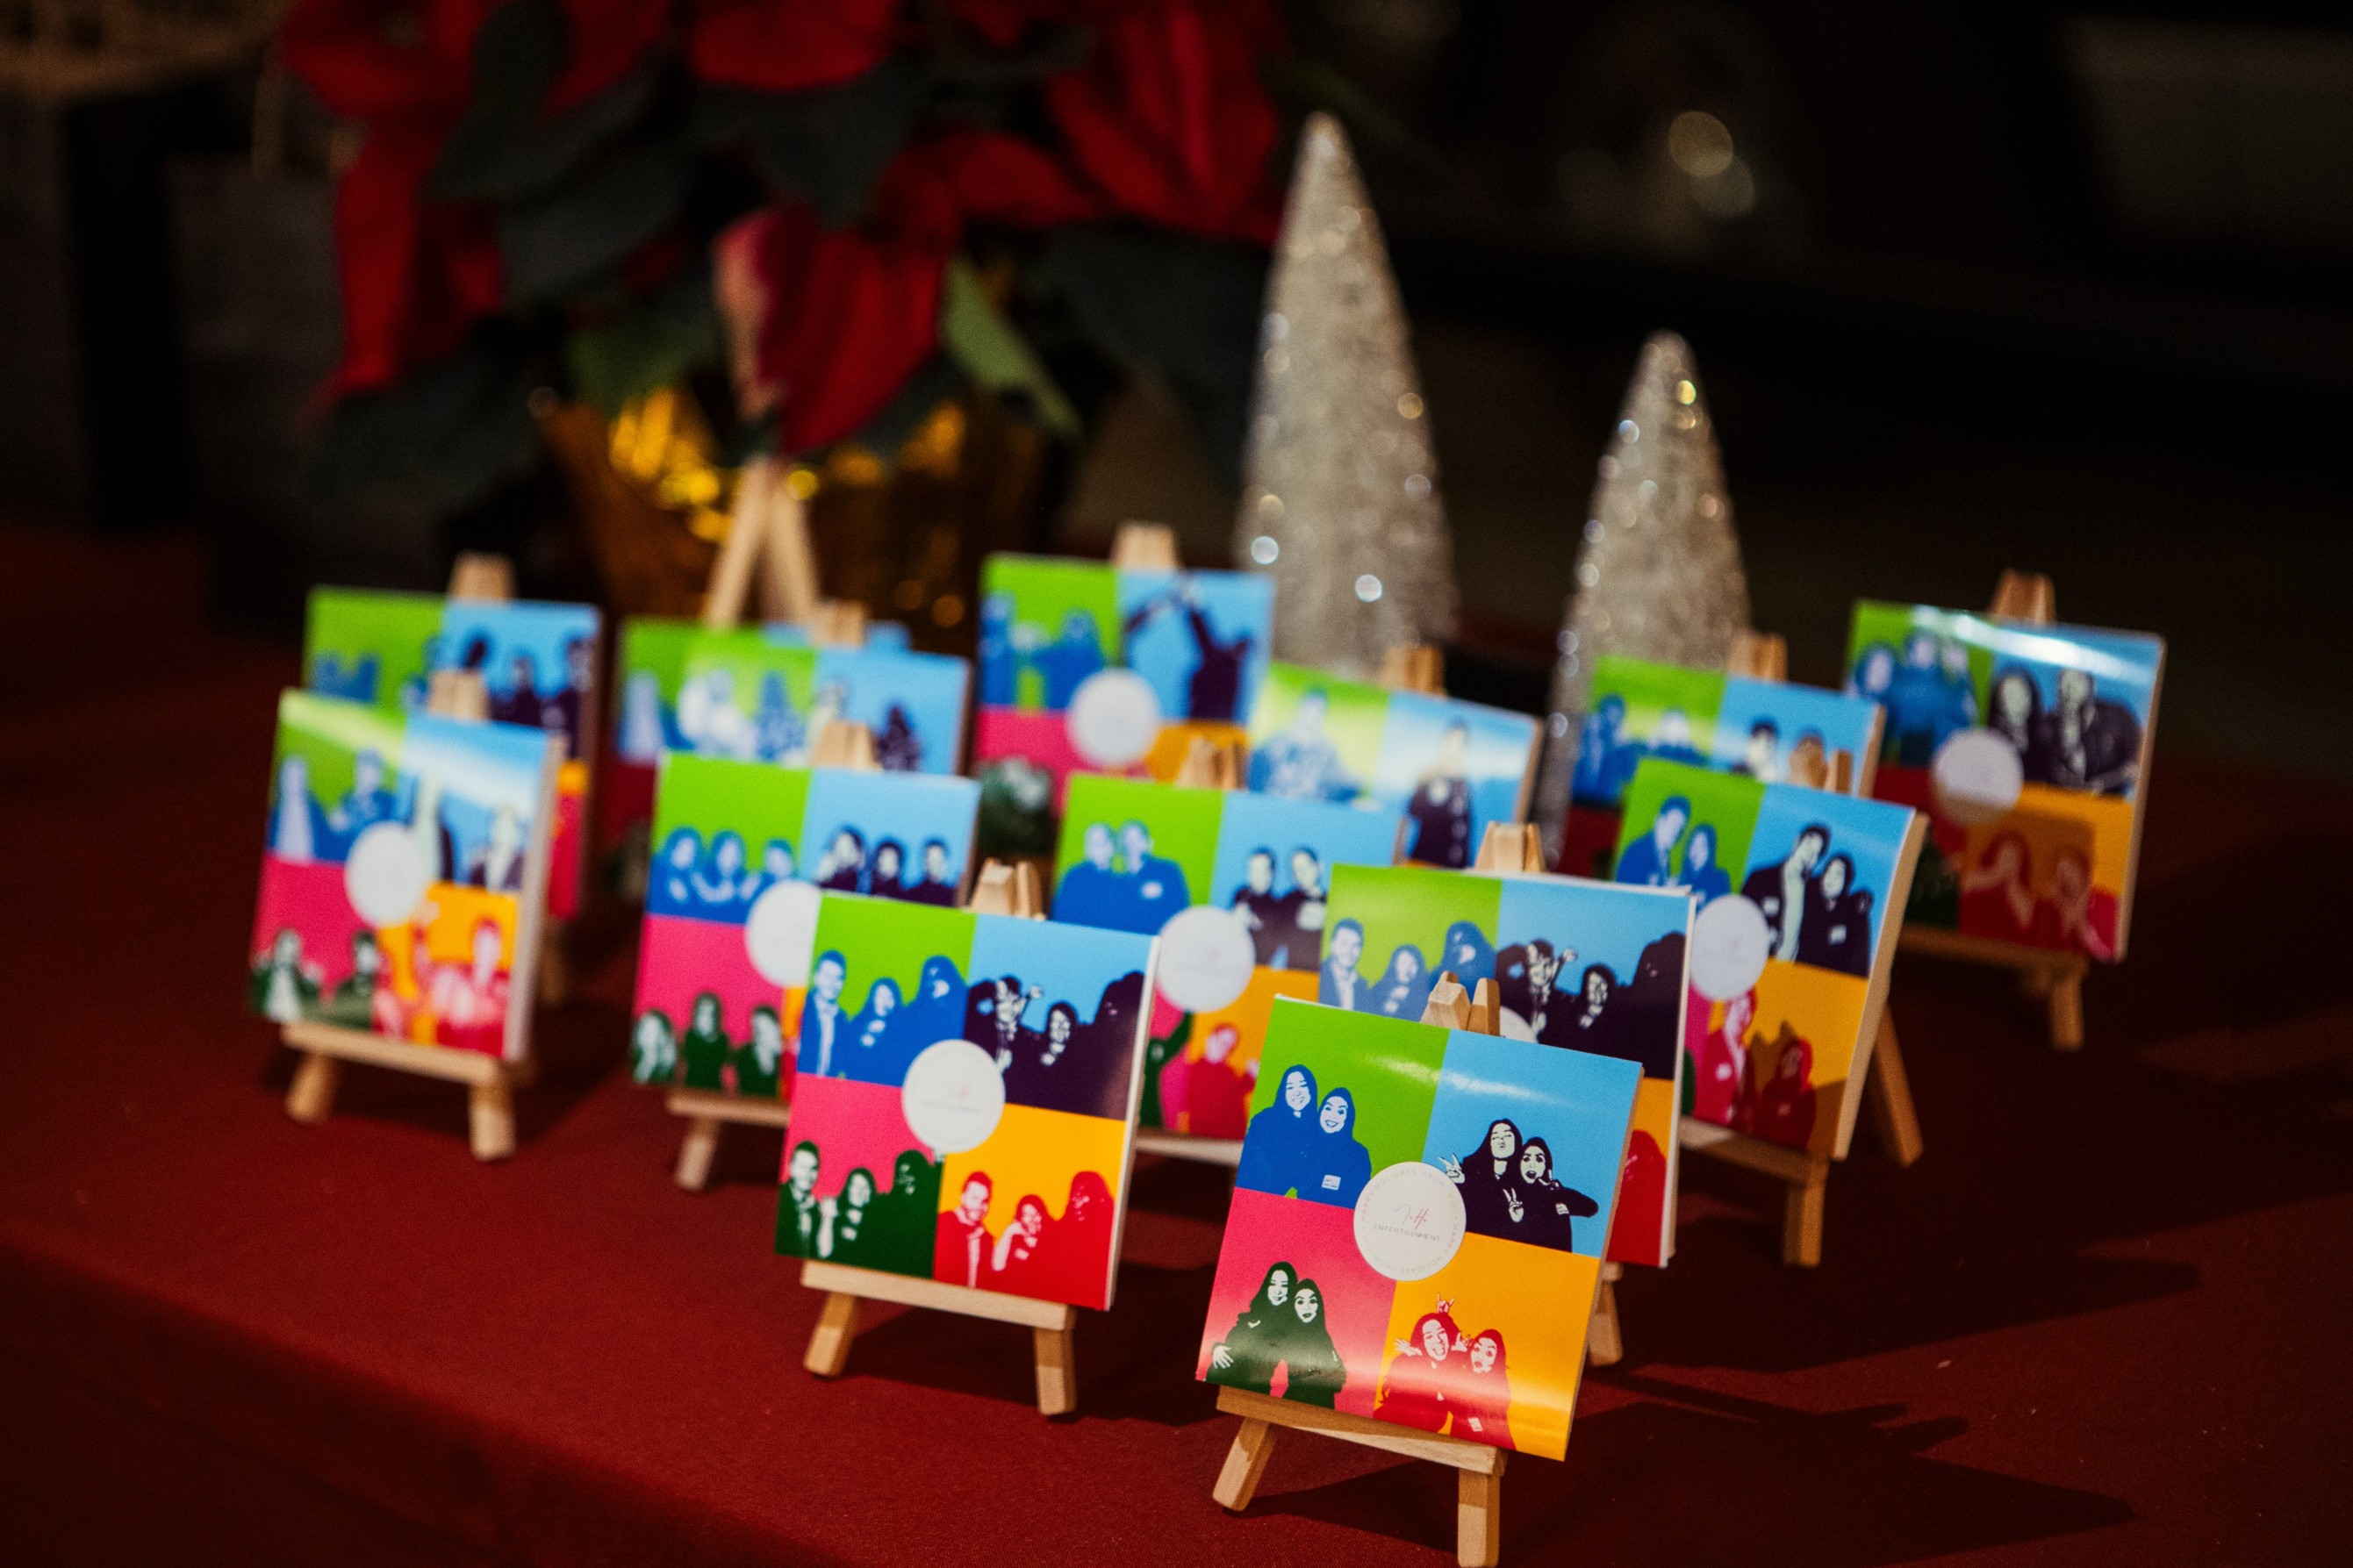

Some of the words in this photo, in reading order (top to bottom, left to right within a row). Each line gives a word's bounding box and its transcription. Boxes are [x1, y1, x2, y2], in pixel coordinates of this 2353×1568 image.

[1361, 1192, 1375, 1221] HAPPY
[1375, 1170, 1417, 1190] HOLIDAYS
[1423, 1169, 1446, 1187] FROM
[1373, 1223, 1441, 1242] ENTERTAINMENT
[1445, 1222, 1459, 1254] HAPPY
[1400, 1255, 1443, 1275] HOLIDAYS
